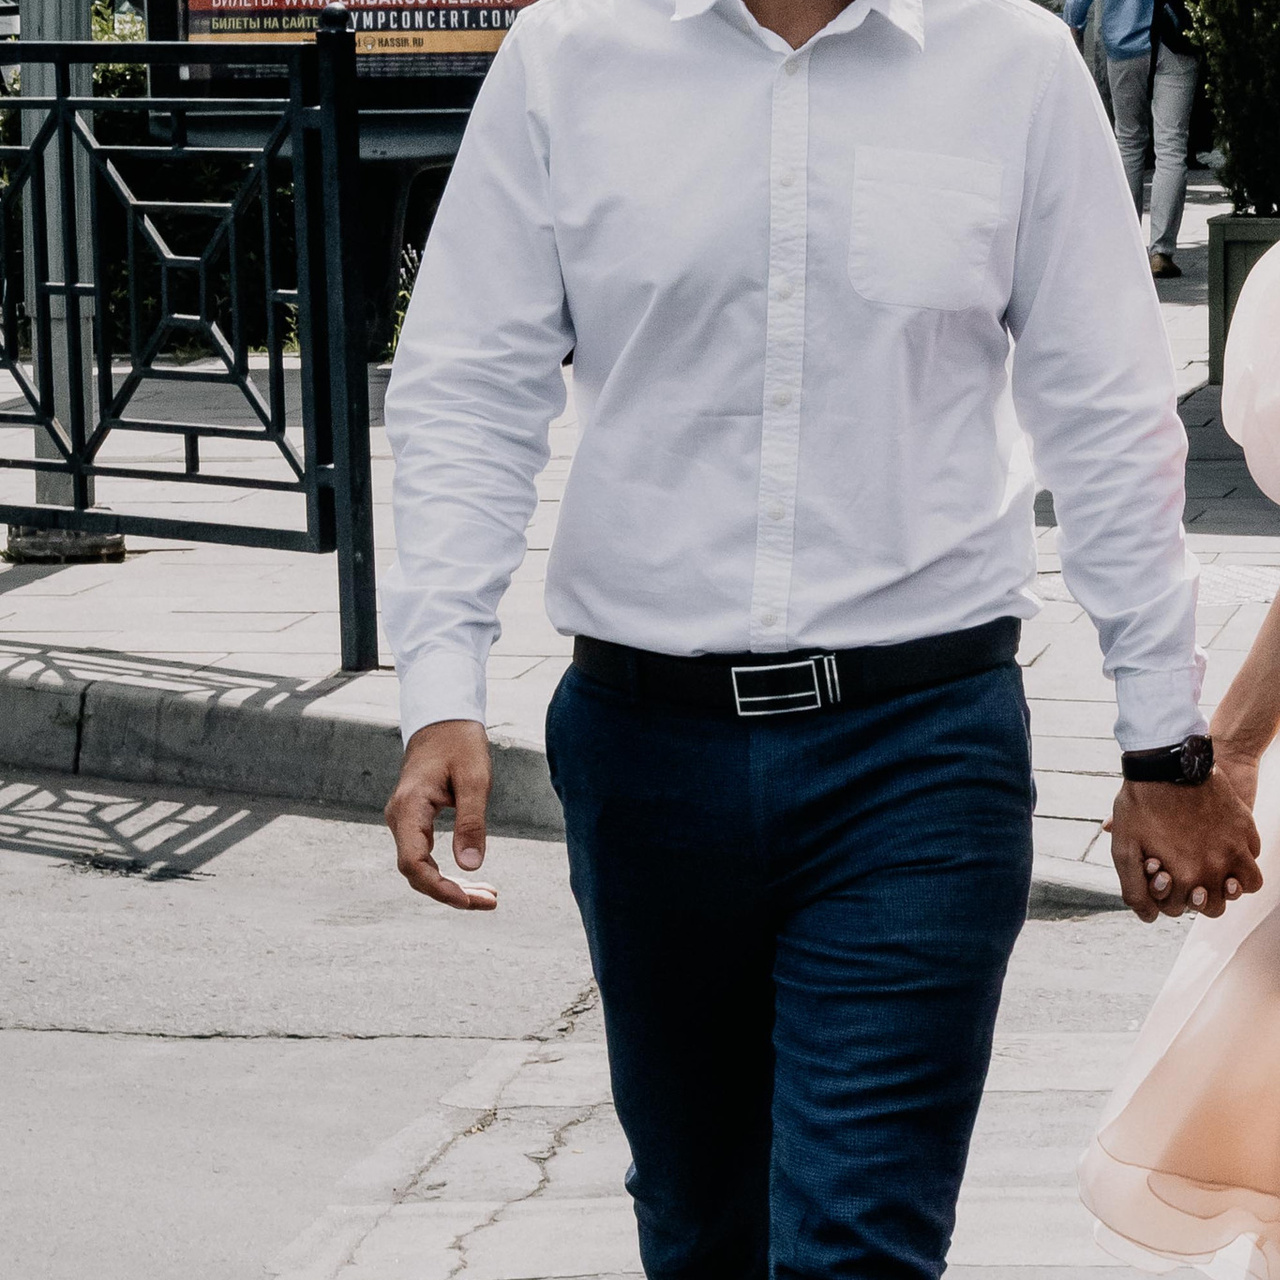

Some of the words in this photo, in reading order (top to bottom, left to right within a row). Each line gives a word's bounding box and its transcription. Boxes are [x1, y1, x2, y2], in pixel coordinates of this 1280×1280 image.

[211, 16, 260, 31] БИЛЕТЫ
[263, 16, 280, 29] НА
[282, 13, 319, 29] САЙТЕ
[350, 9, 515, 29] YMPCONCERT.COM
